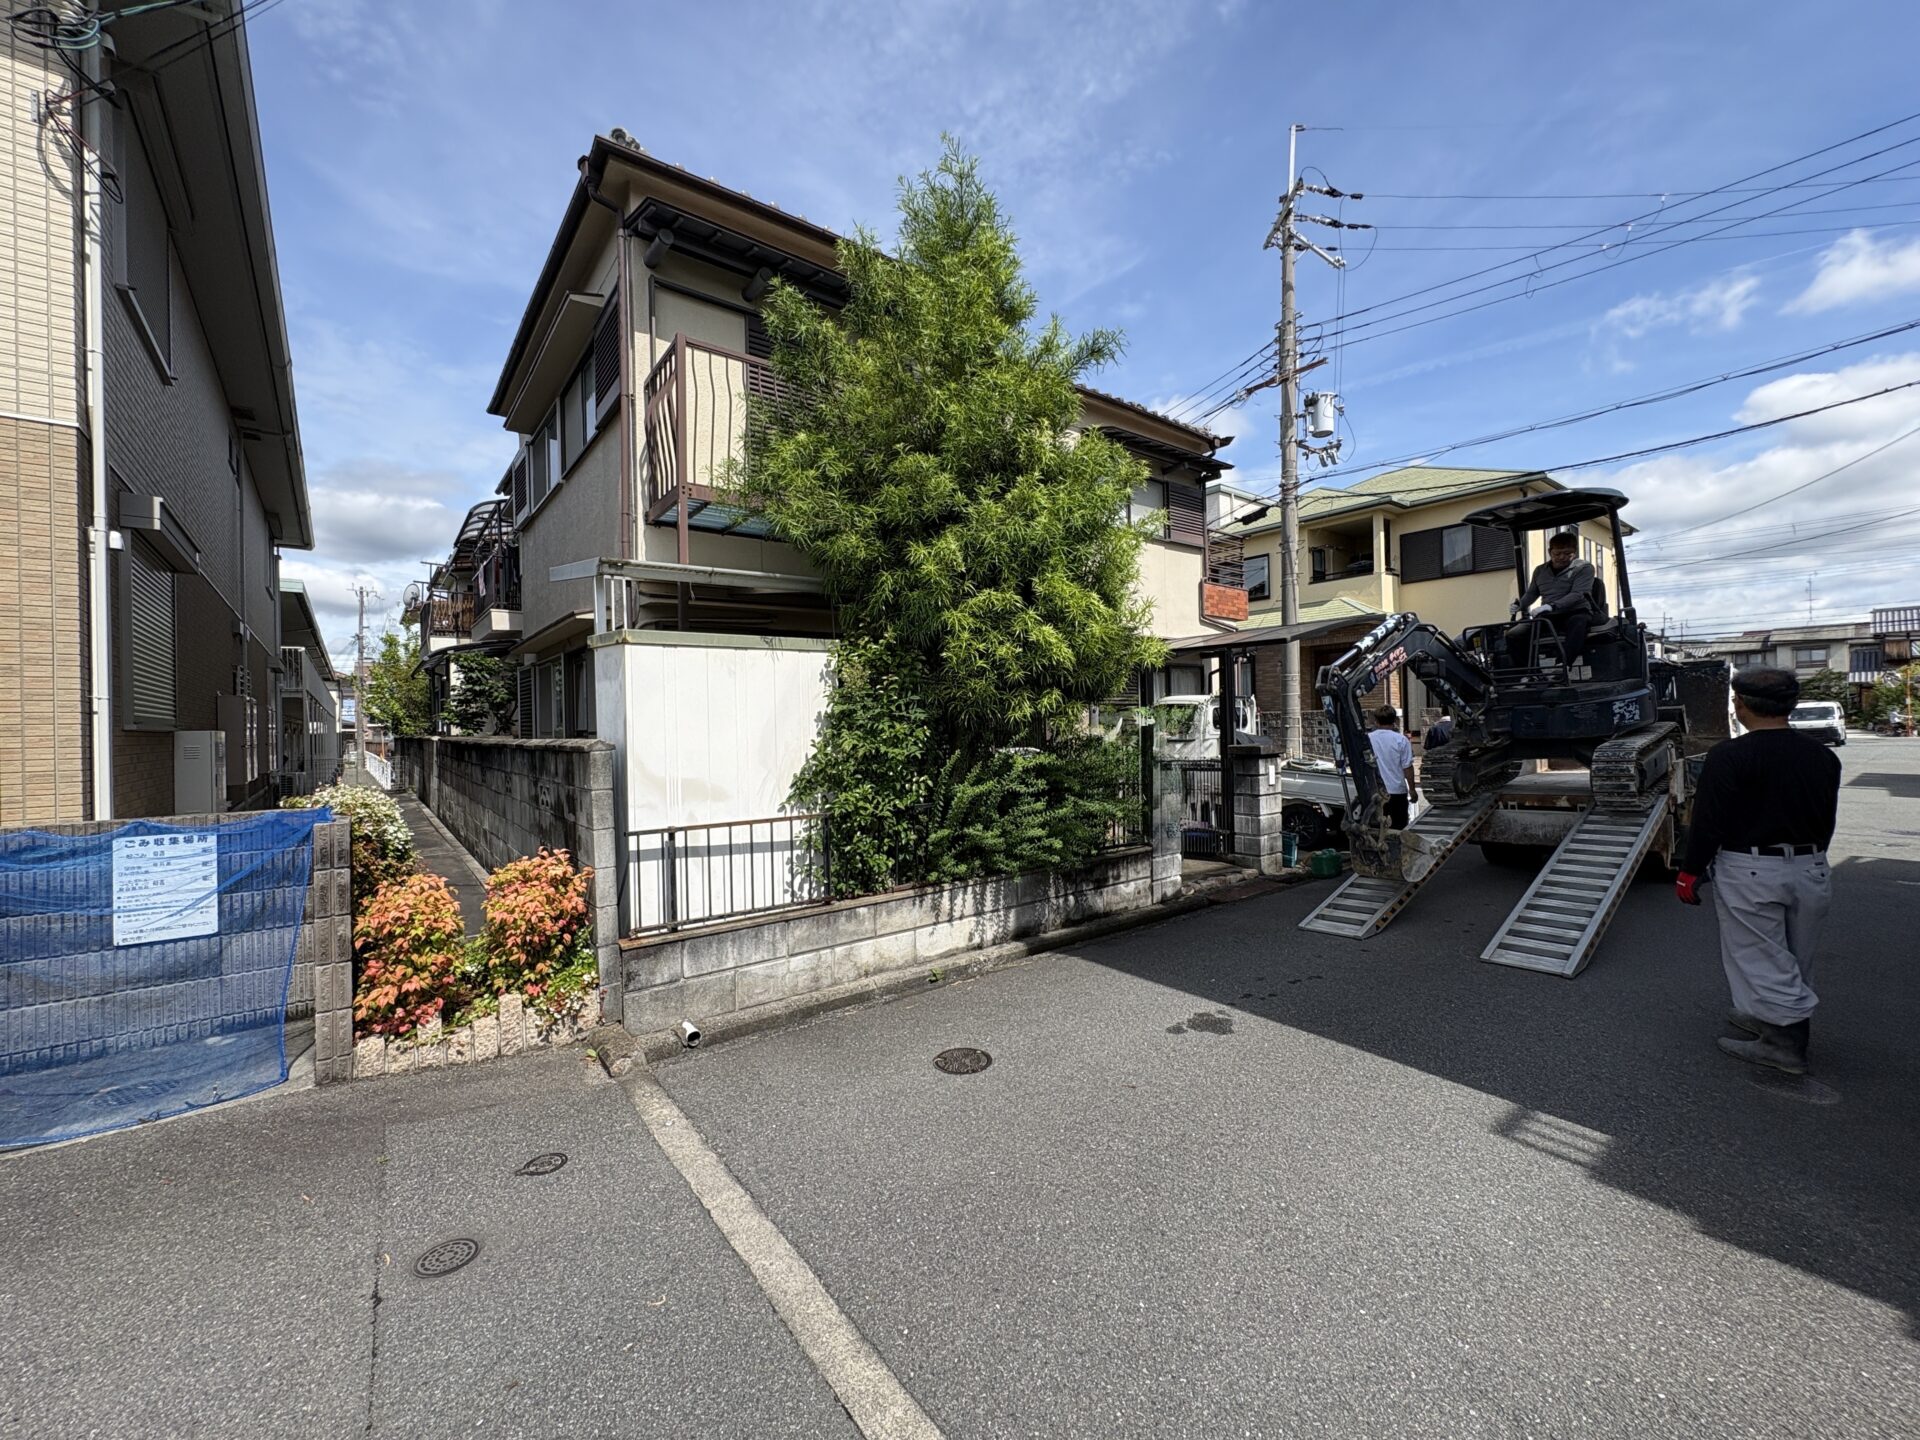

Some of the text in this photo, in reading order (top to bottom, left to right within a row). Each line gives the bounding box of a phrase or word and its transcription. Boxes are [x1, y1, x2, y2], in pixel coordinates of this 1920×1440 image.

[124, 834, 208, 849] ごみ収集場所
